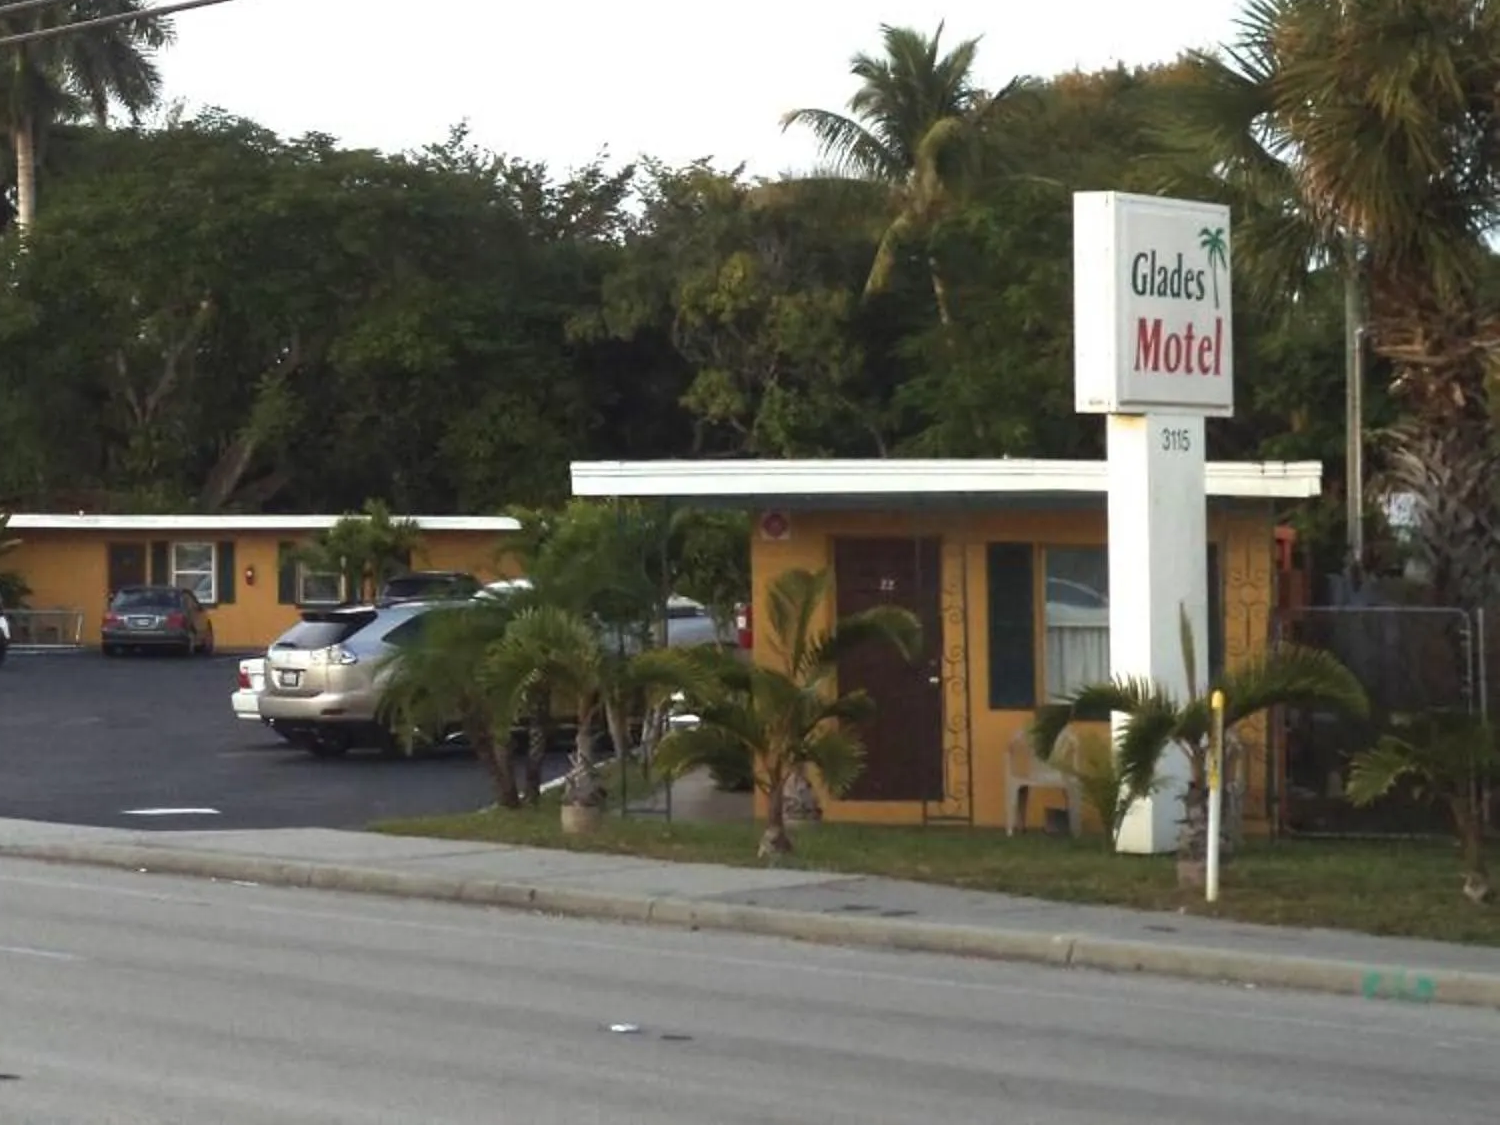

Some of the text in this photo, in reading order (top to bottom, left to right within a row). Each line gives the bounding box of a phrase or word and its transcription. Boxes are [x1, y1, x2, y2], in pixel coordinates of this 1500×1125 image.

[1131, 249, 1205, 302] Glades
[1134, 316, 1223, 376] Motel
[1162, 427, 1191, 452] 3115
